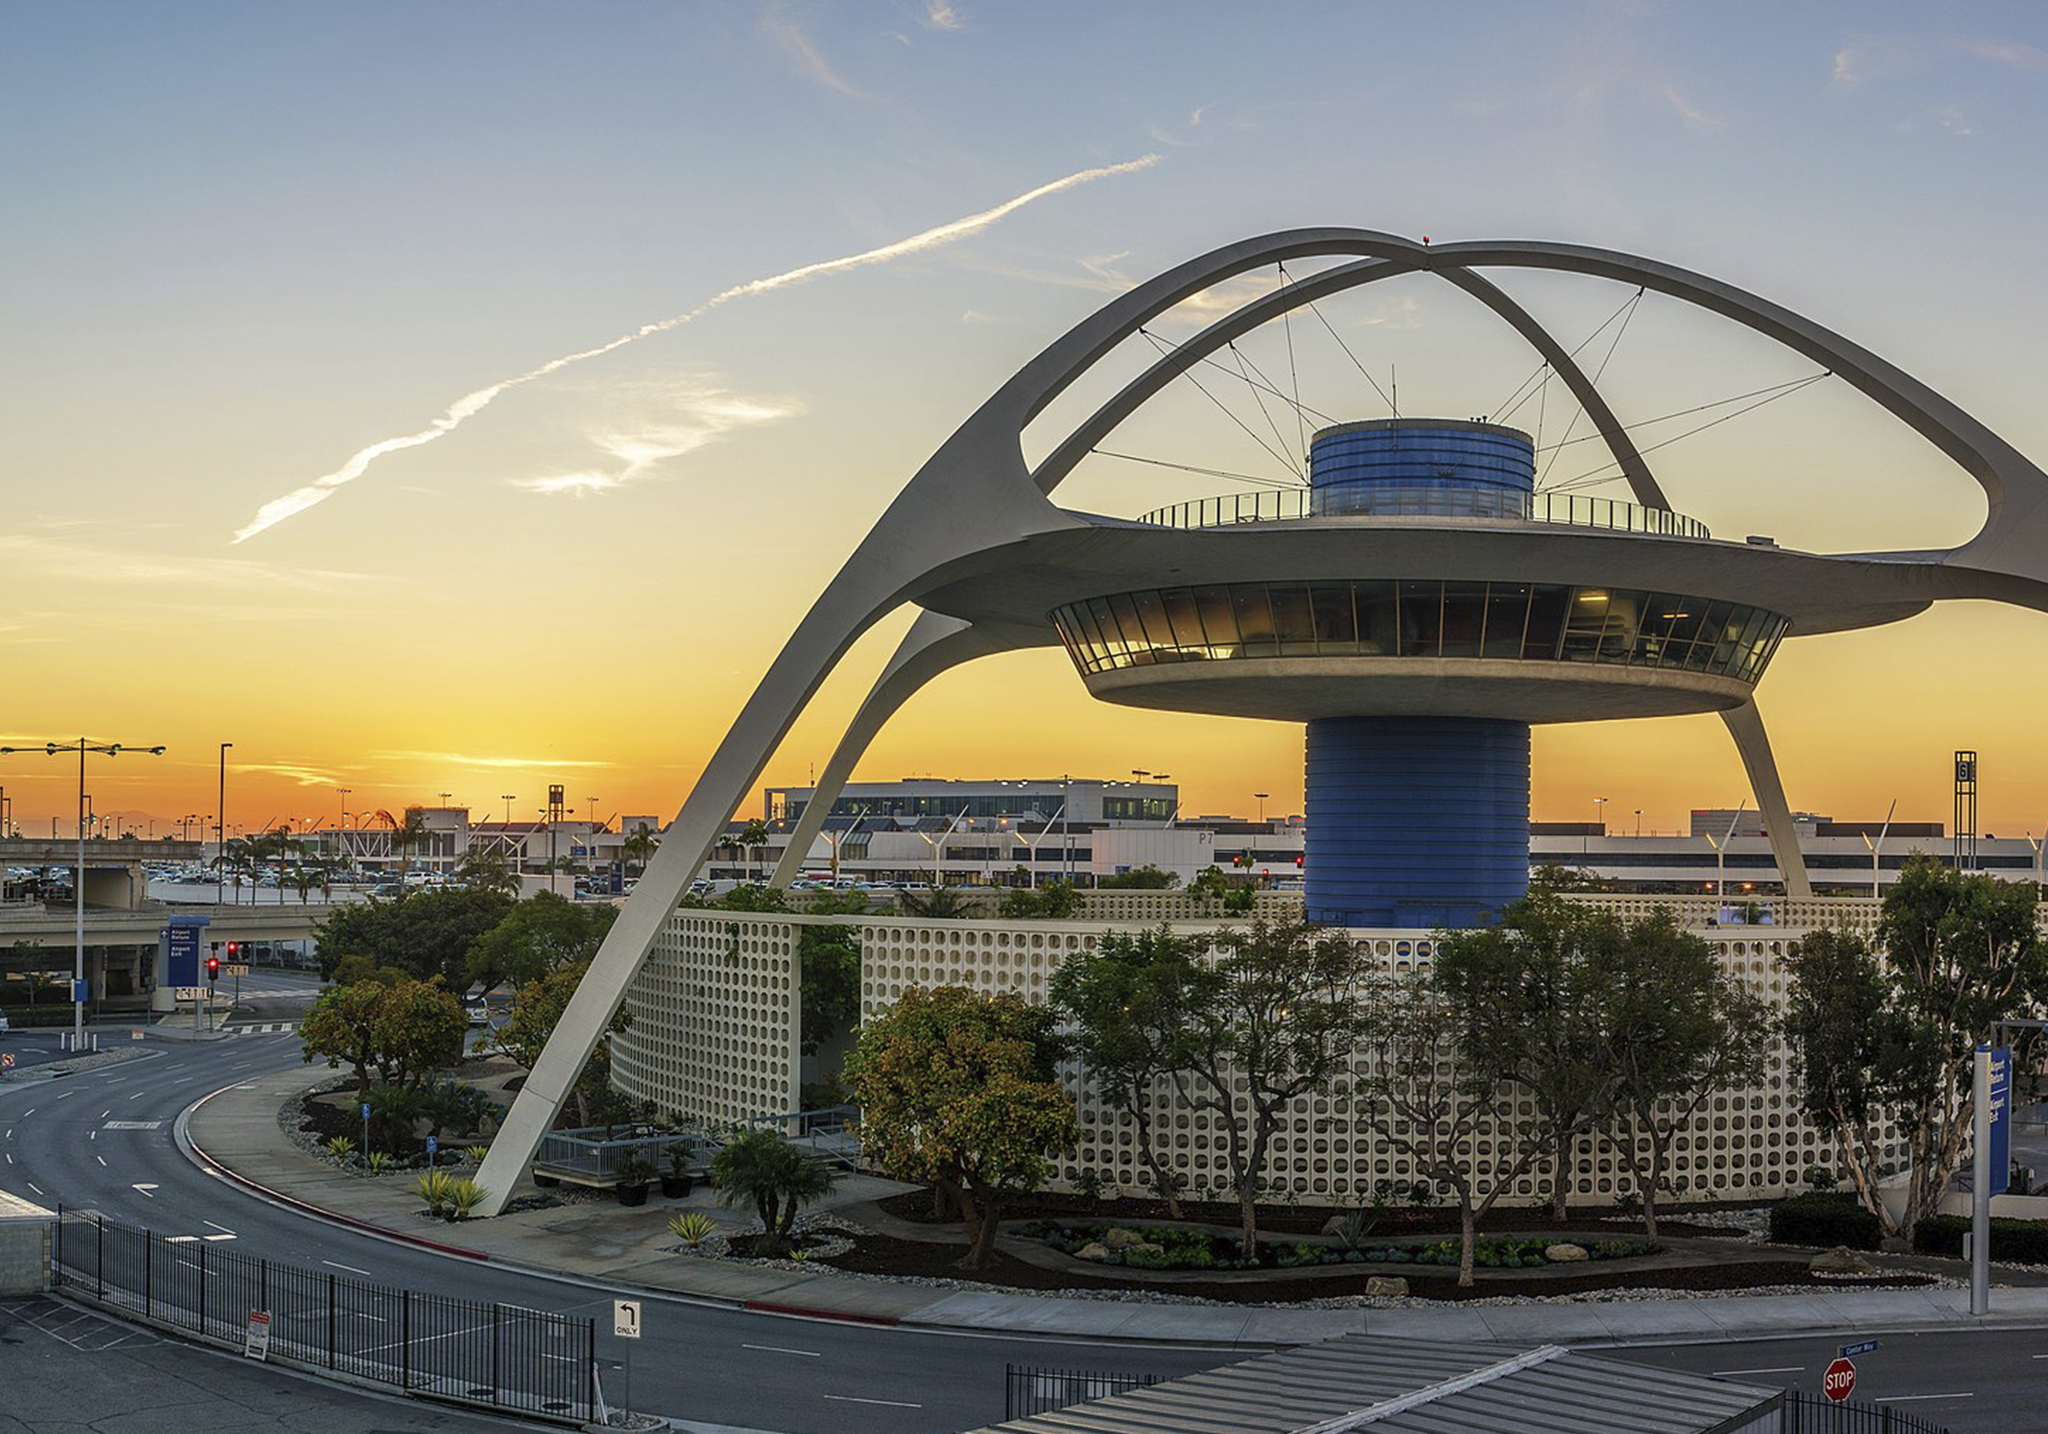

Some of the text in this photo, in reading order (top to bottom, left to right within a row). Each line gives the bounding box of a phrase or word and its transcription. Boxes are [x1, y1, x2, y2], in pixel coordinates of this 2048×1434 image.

[1959, 765, 1967, 778] 6
[616, 1326, 638, 1335] ONLY
[1846, 1343, 1874, 1356] Center Way
[1826, 1370, 1854, 1390] STOP
